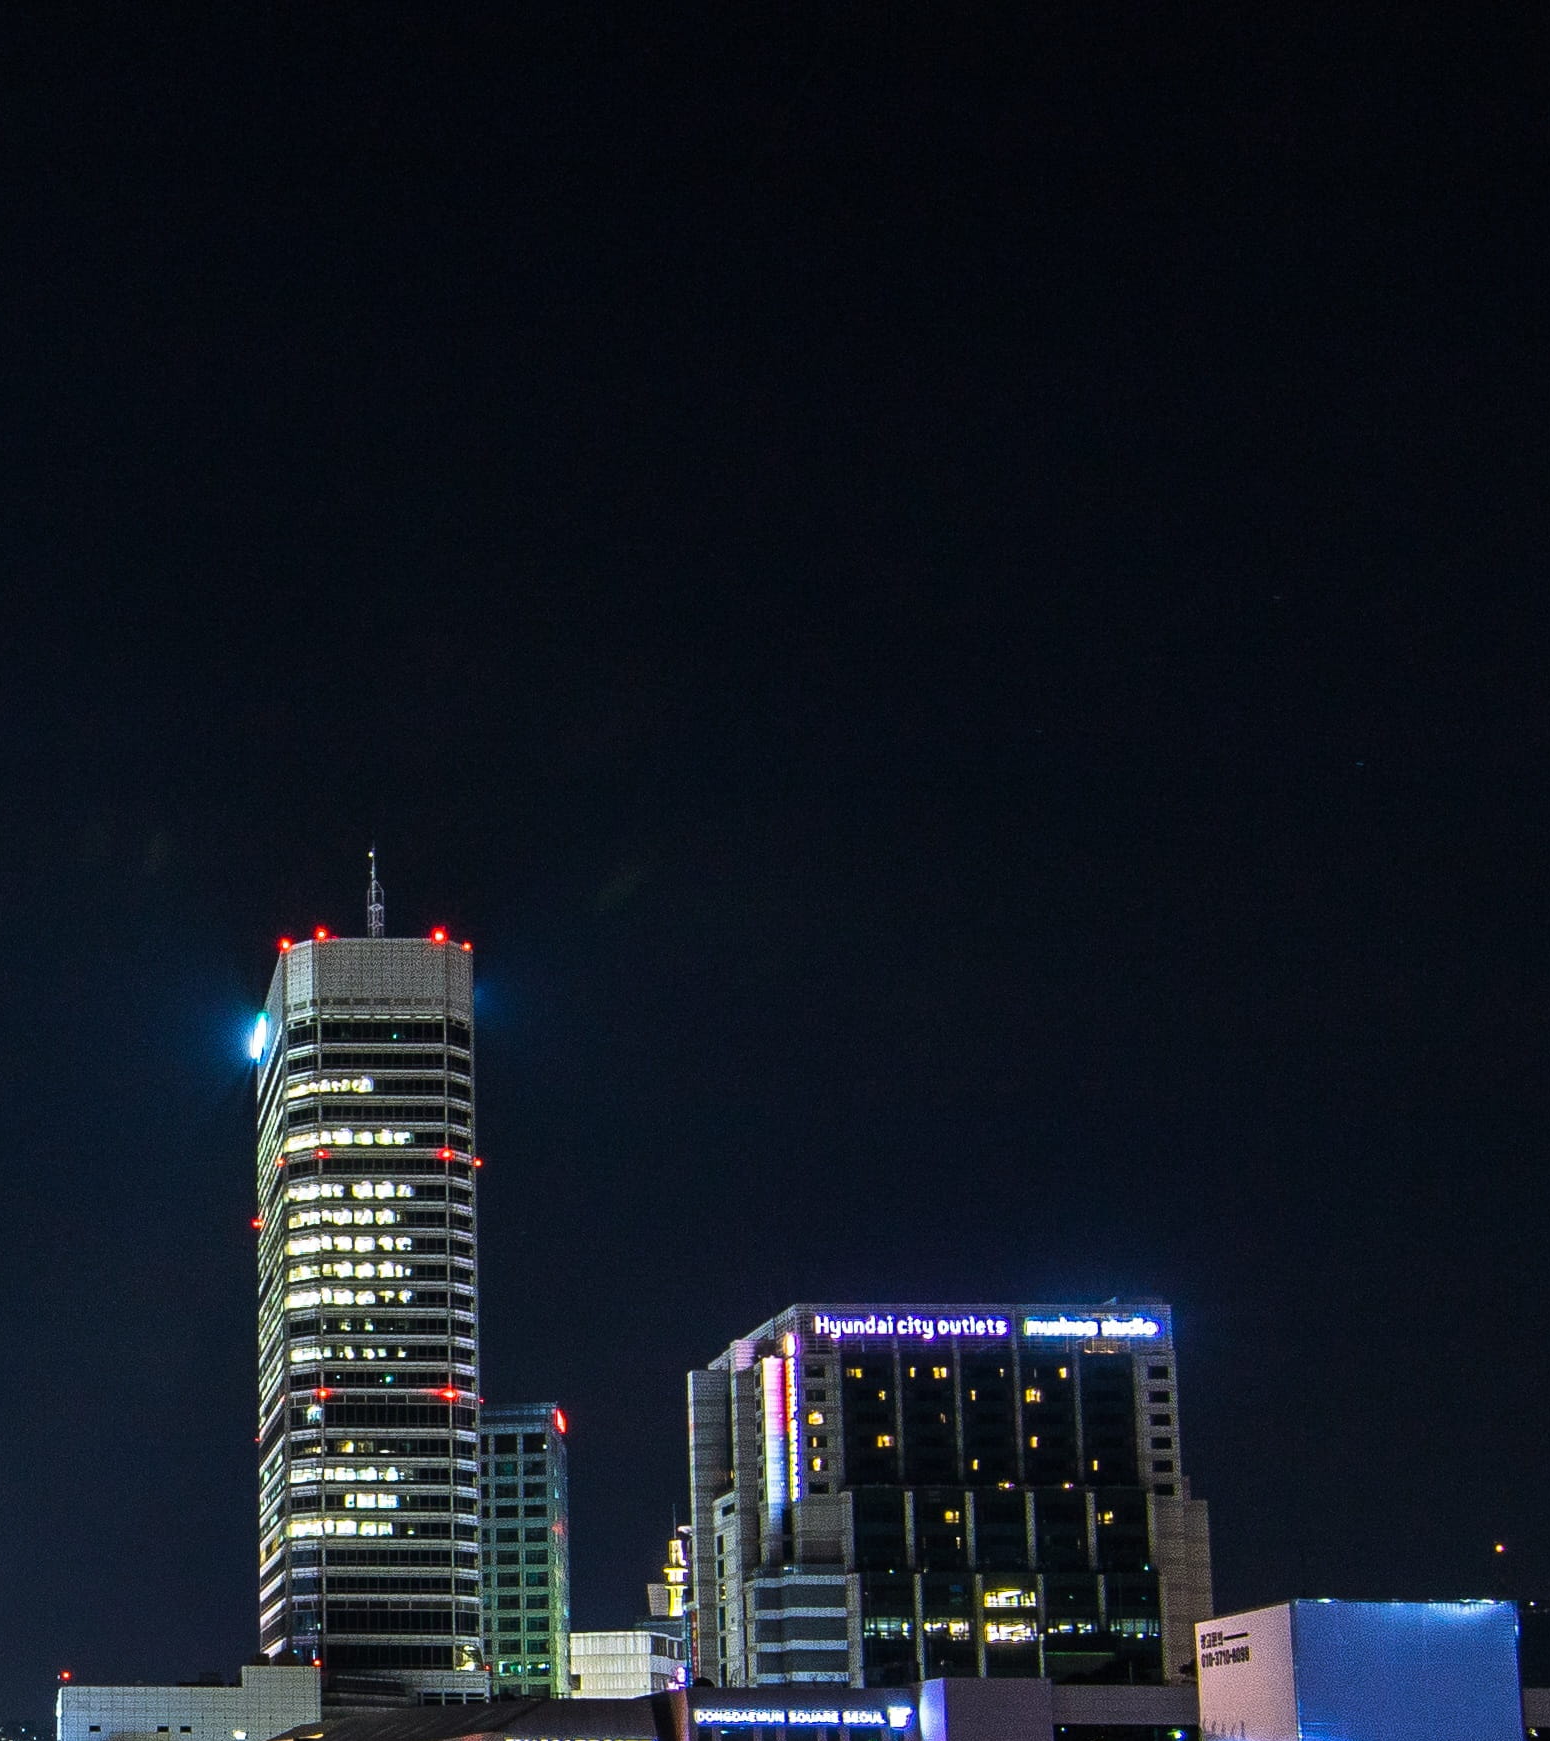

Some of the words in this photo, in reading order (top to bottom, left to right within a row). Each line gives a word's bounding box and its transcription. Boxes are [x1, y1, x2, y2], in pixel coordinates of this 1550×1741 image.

[814, 1314, 894, 1339] Hyundai
[897, 1315, 934, 1340] city
[938, 1315, 1009, 1335] outlets
[694, 1709, 786, 1724] DONGDAEMUN
[788, 1709, 841, 1724] SQUARE
[843, 1710, 886, 1724] SEOUL
